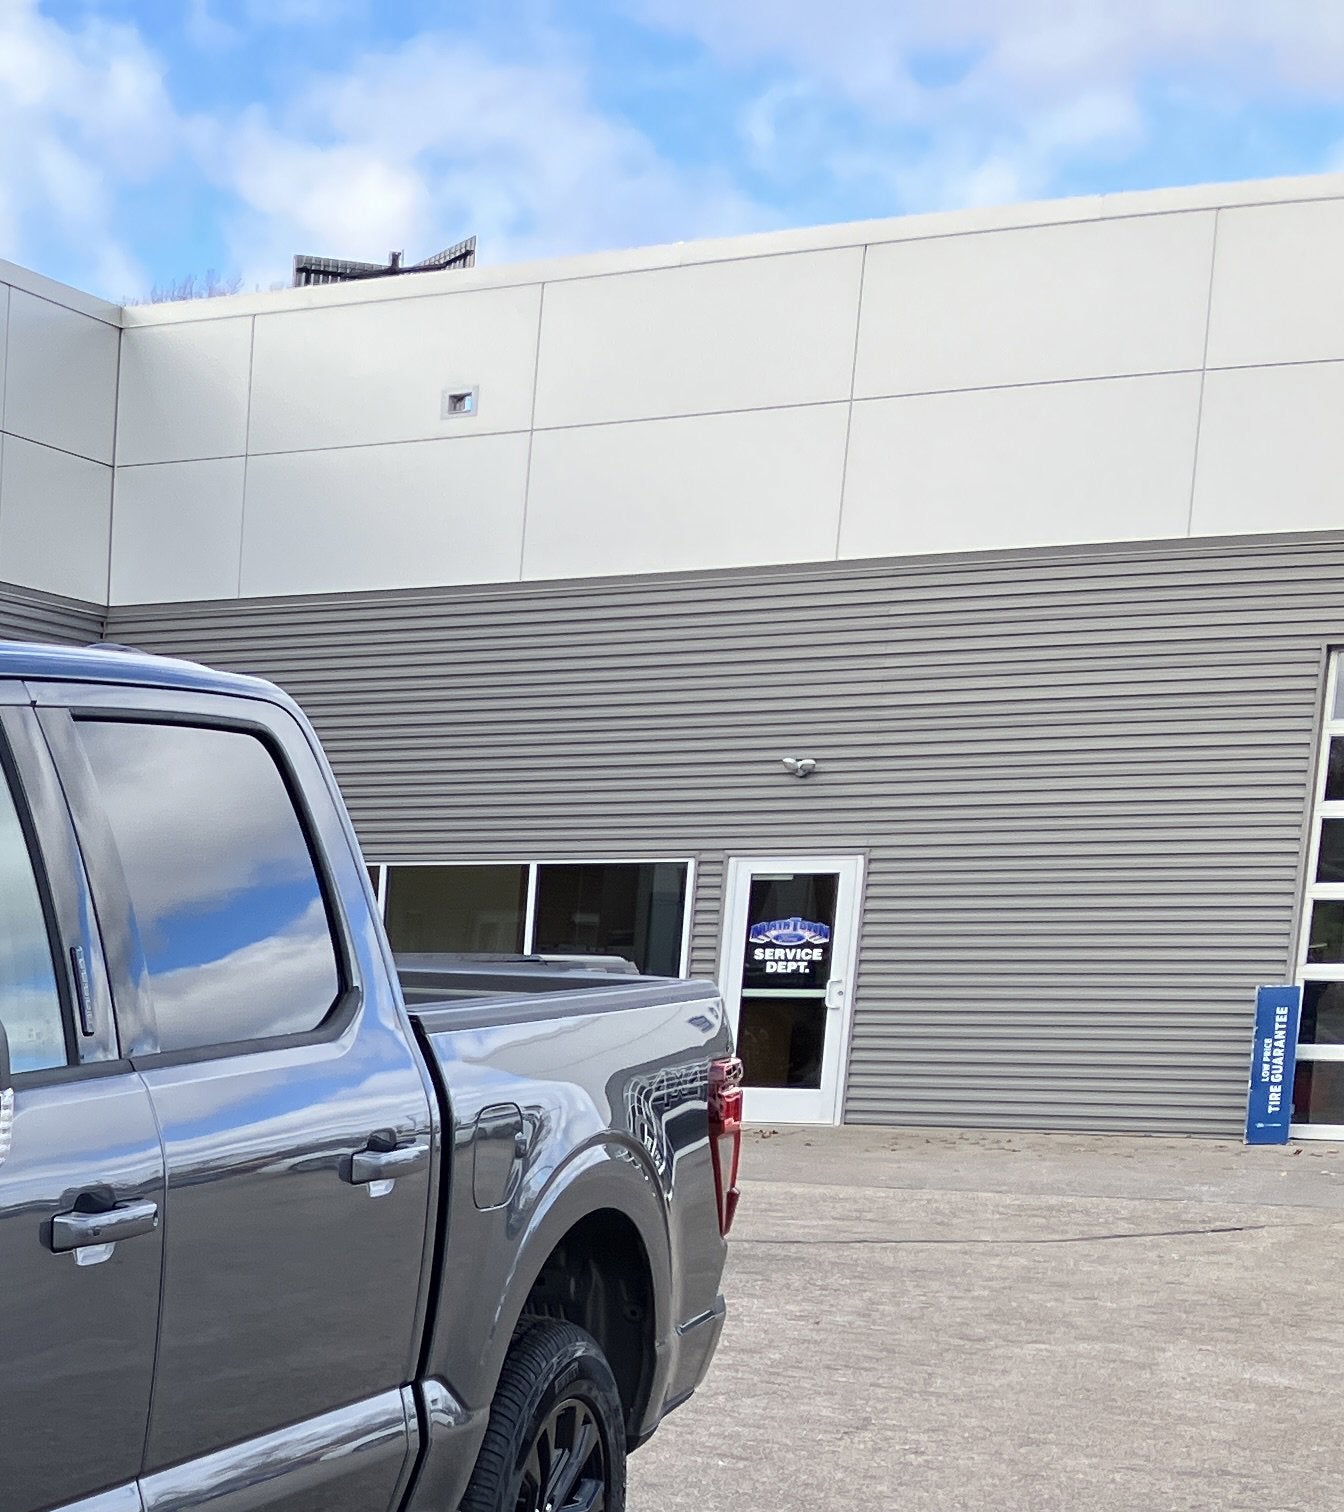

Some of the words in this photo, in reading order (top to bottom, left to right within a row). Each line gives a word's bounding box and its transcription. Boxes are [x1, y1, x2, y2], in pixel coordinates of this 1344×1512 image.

[753, 948, 823, 960] SERVICE
[765, 961, 810, 973] DEPT.
[1263, 1038, 1273, 1061] PRICE
[1270, 1006, 1289, 1083] GUARANTEE
[1261, 1062, 1270, 1082] LOW
[1268, 1085, 1282, 1114] TIRE
